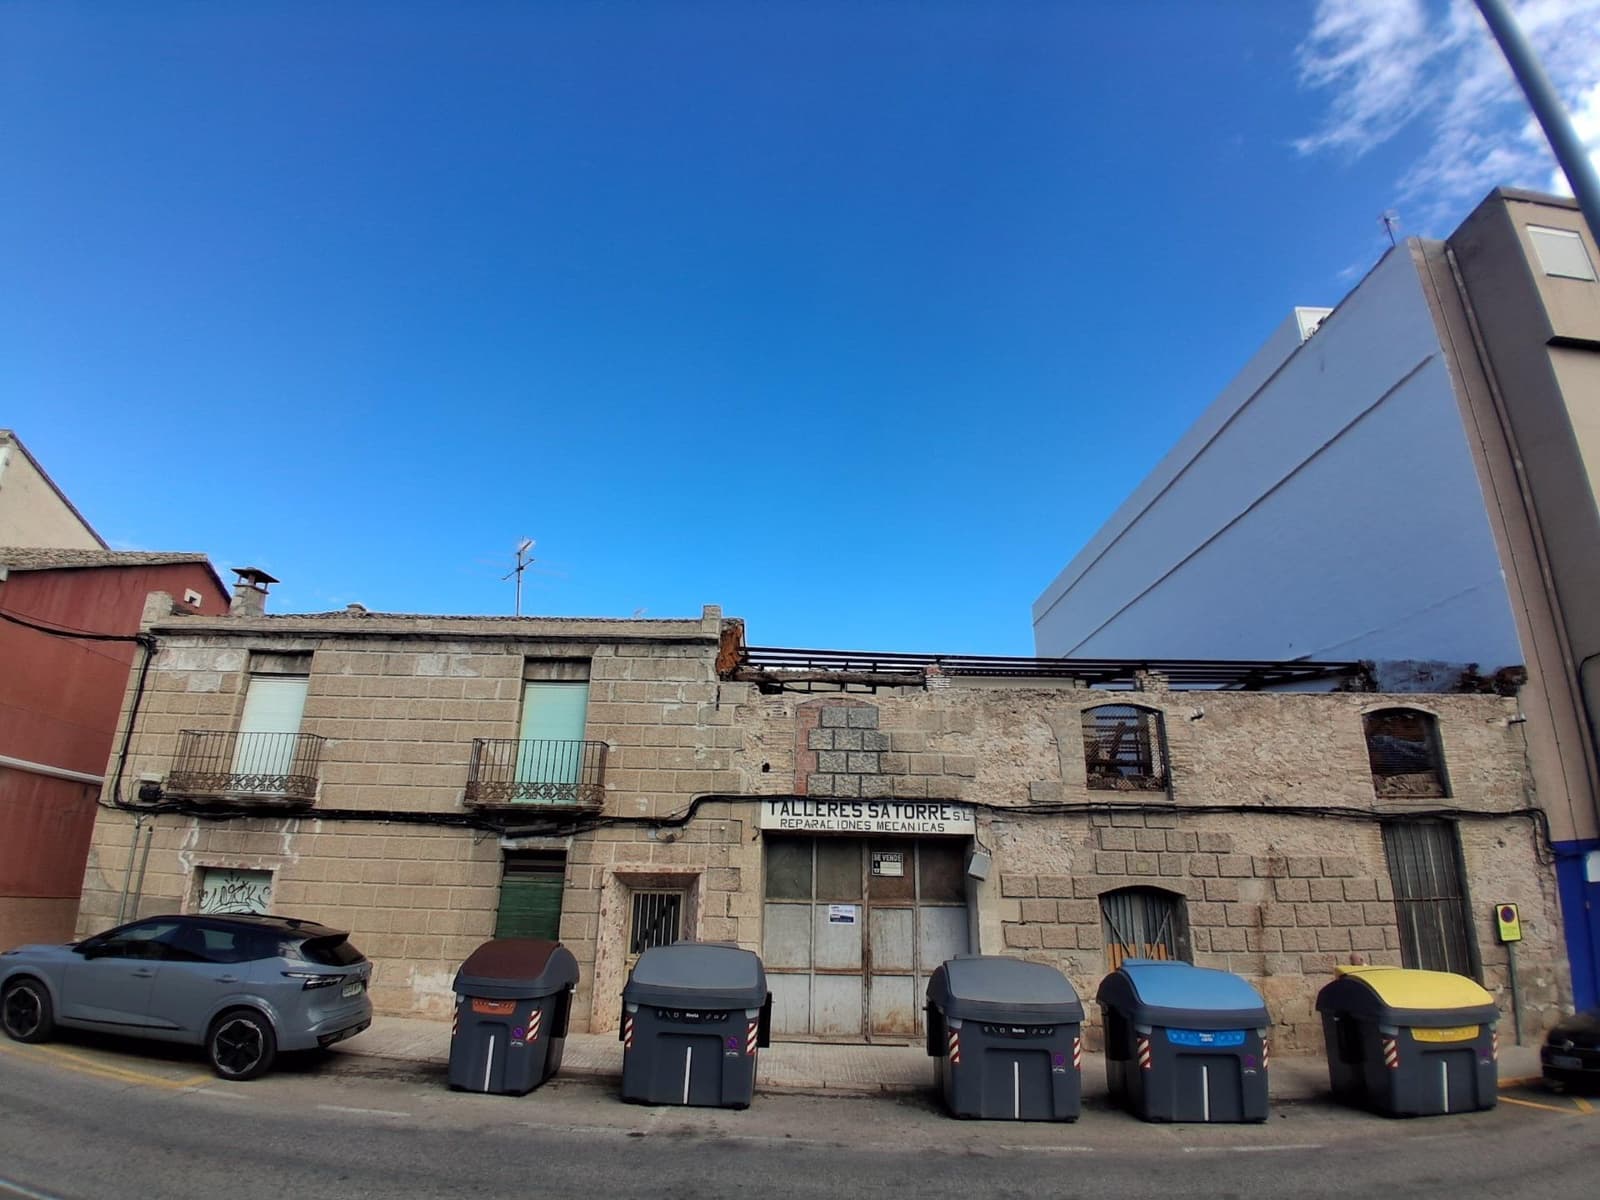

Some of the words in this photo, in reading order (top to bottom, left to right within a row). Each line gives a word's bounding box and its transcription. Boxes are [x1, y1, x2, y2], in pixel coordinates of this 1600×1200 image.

[767, 800, 863, 818] TALLERES
[868, 801, 951, 820] SATORRE
[780, 819, 871, 831] REPARACIONES
[876, 821, 945, 832] MECANICAS
[882, 854, 902, 862] VENDE
